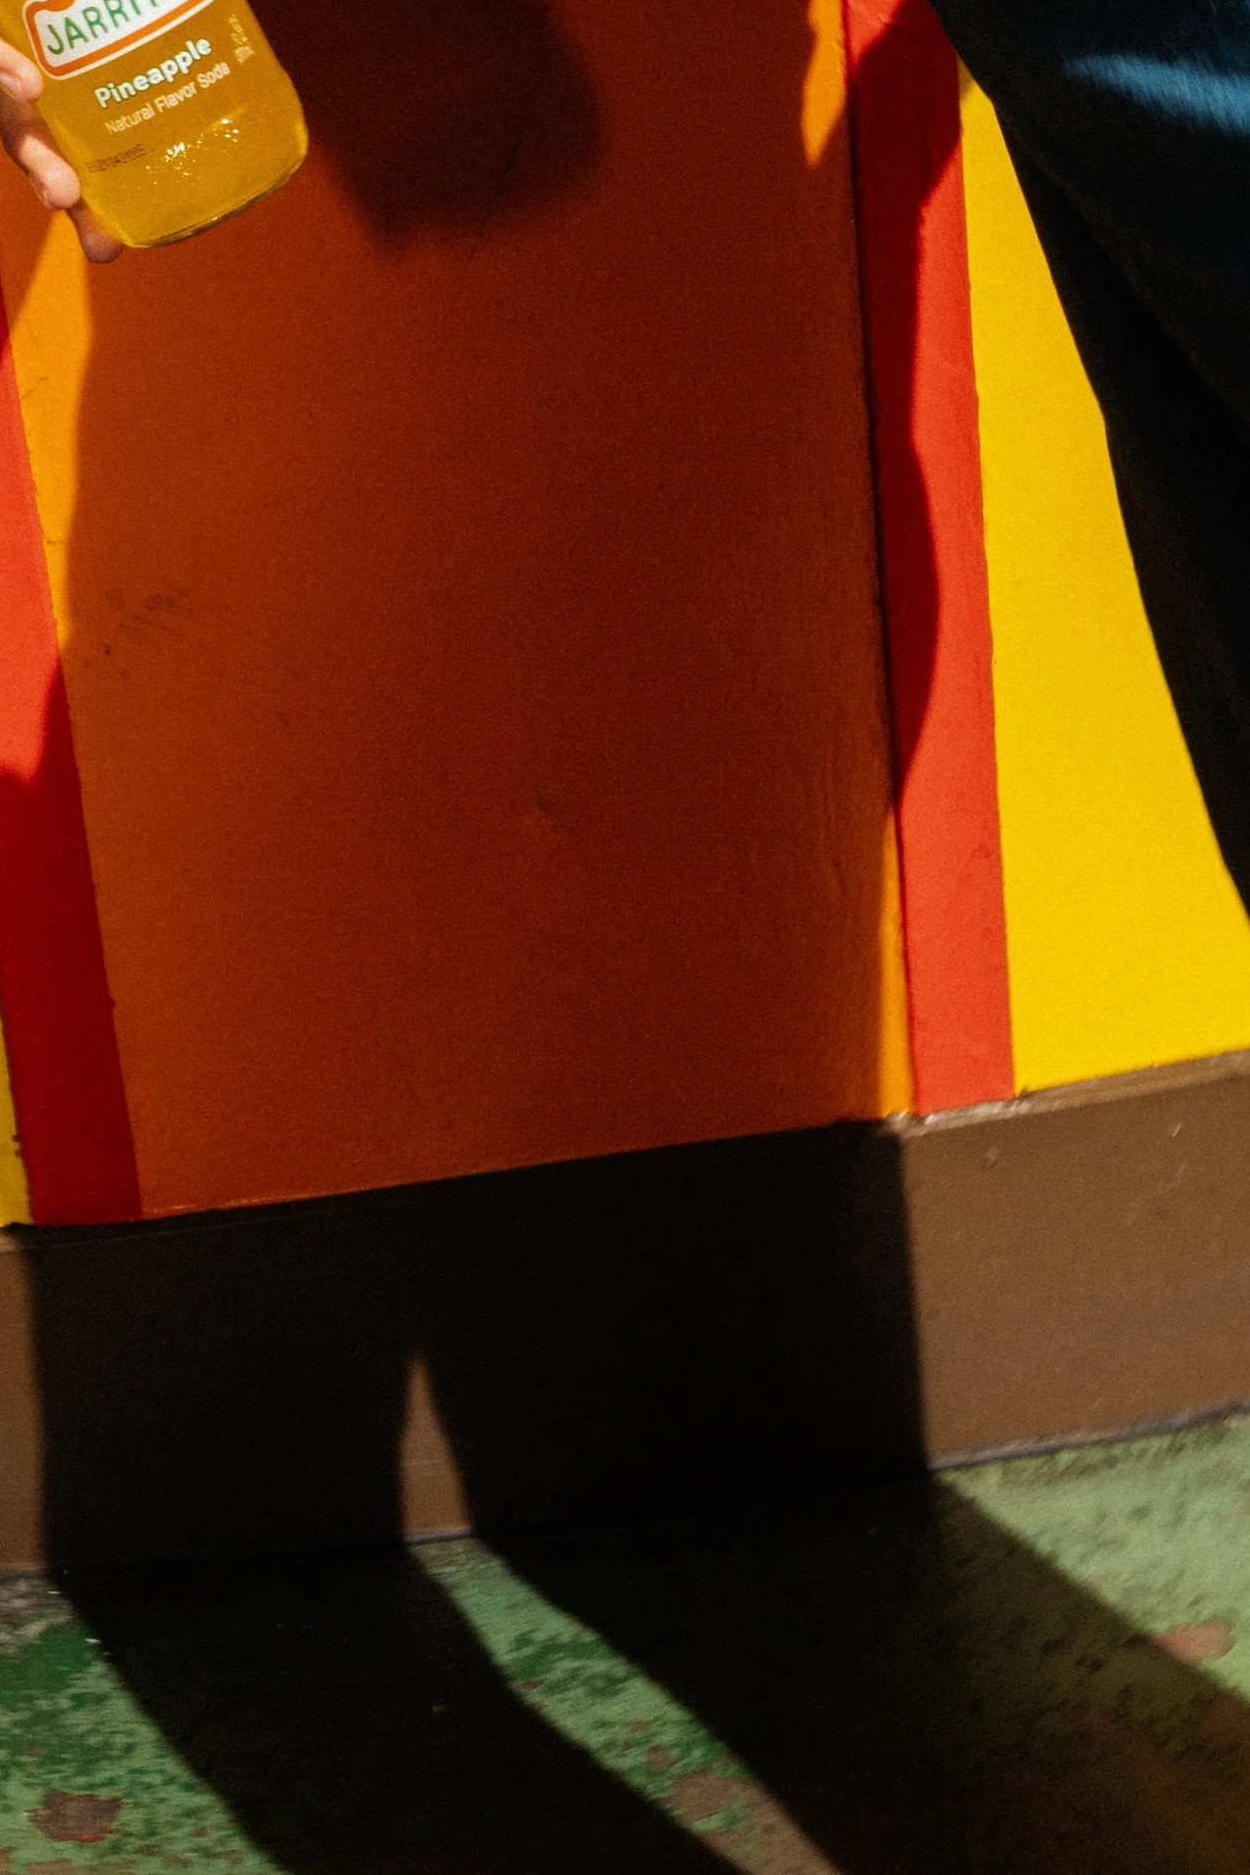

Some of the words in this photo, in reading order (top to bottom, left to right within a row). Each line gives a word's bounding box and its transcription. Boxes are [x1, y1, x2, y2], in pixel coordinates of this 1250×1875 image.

[94, 38, 213, 109] Pineapple
[106, 103, 156, 135] Natural
[154, 81, 198, 113] Flavor
